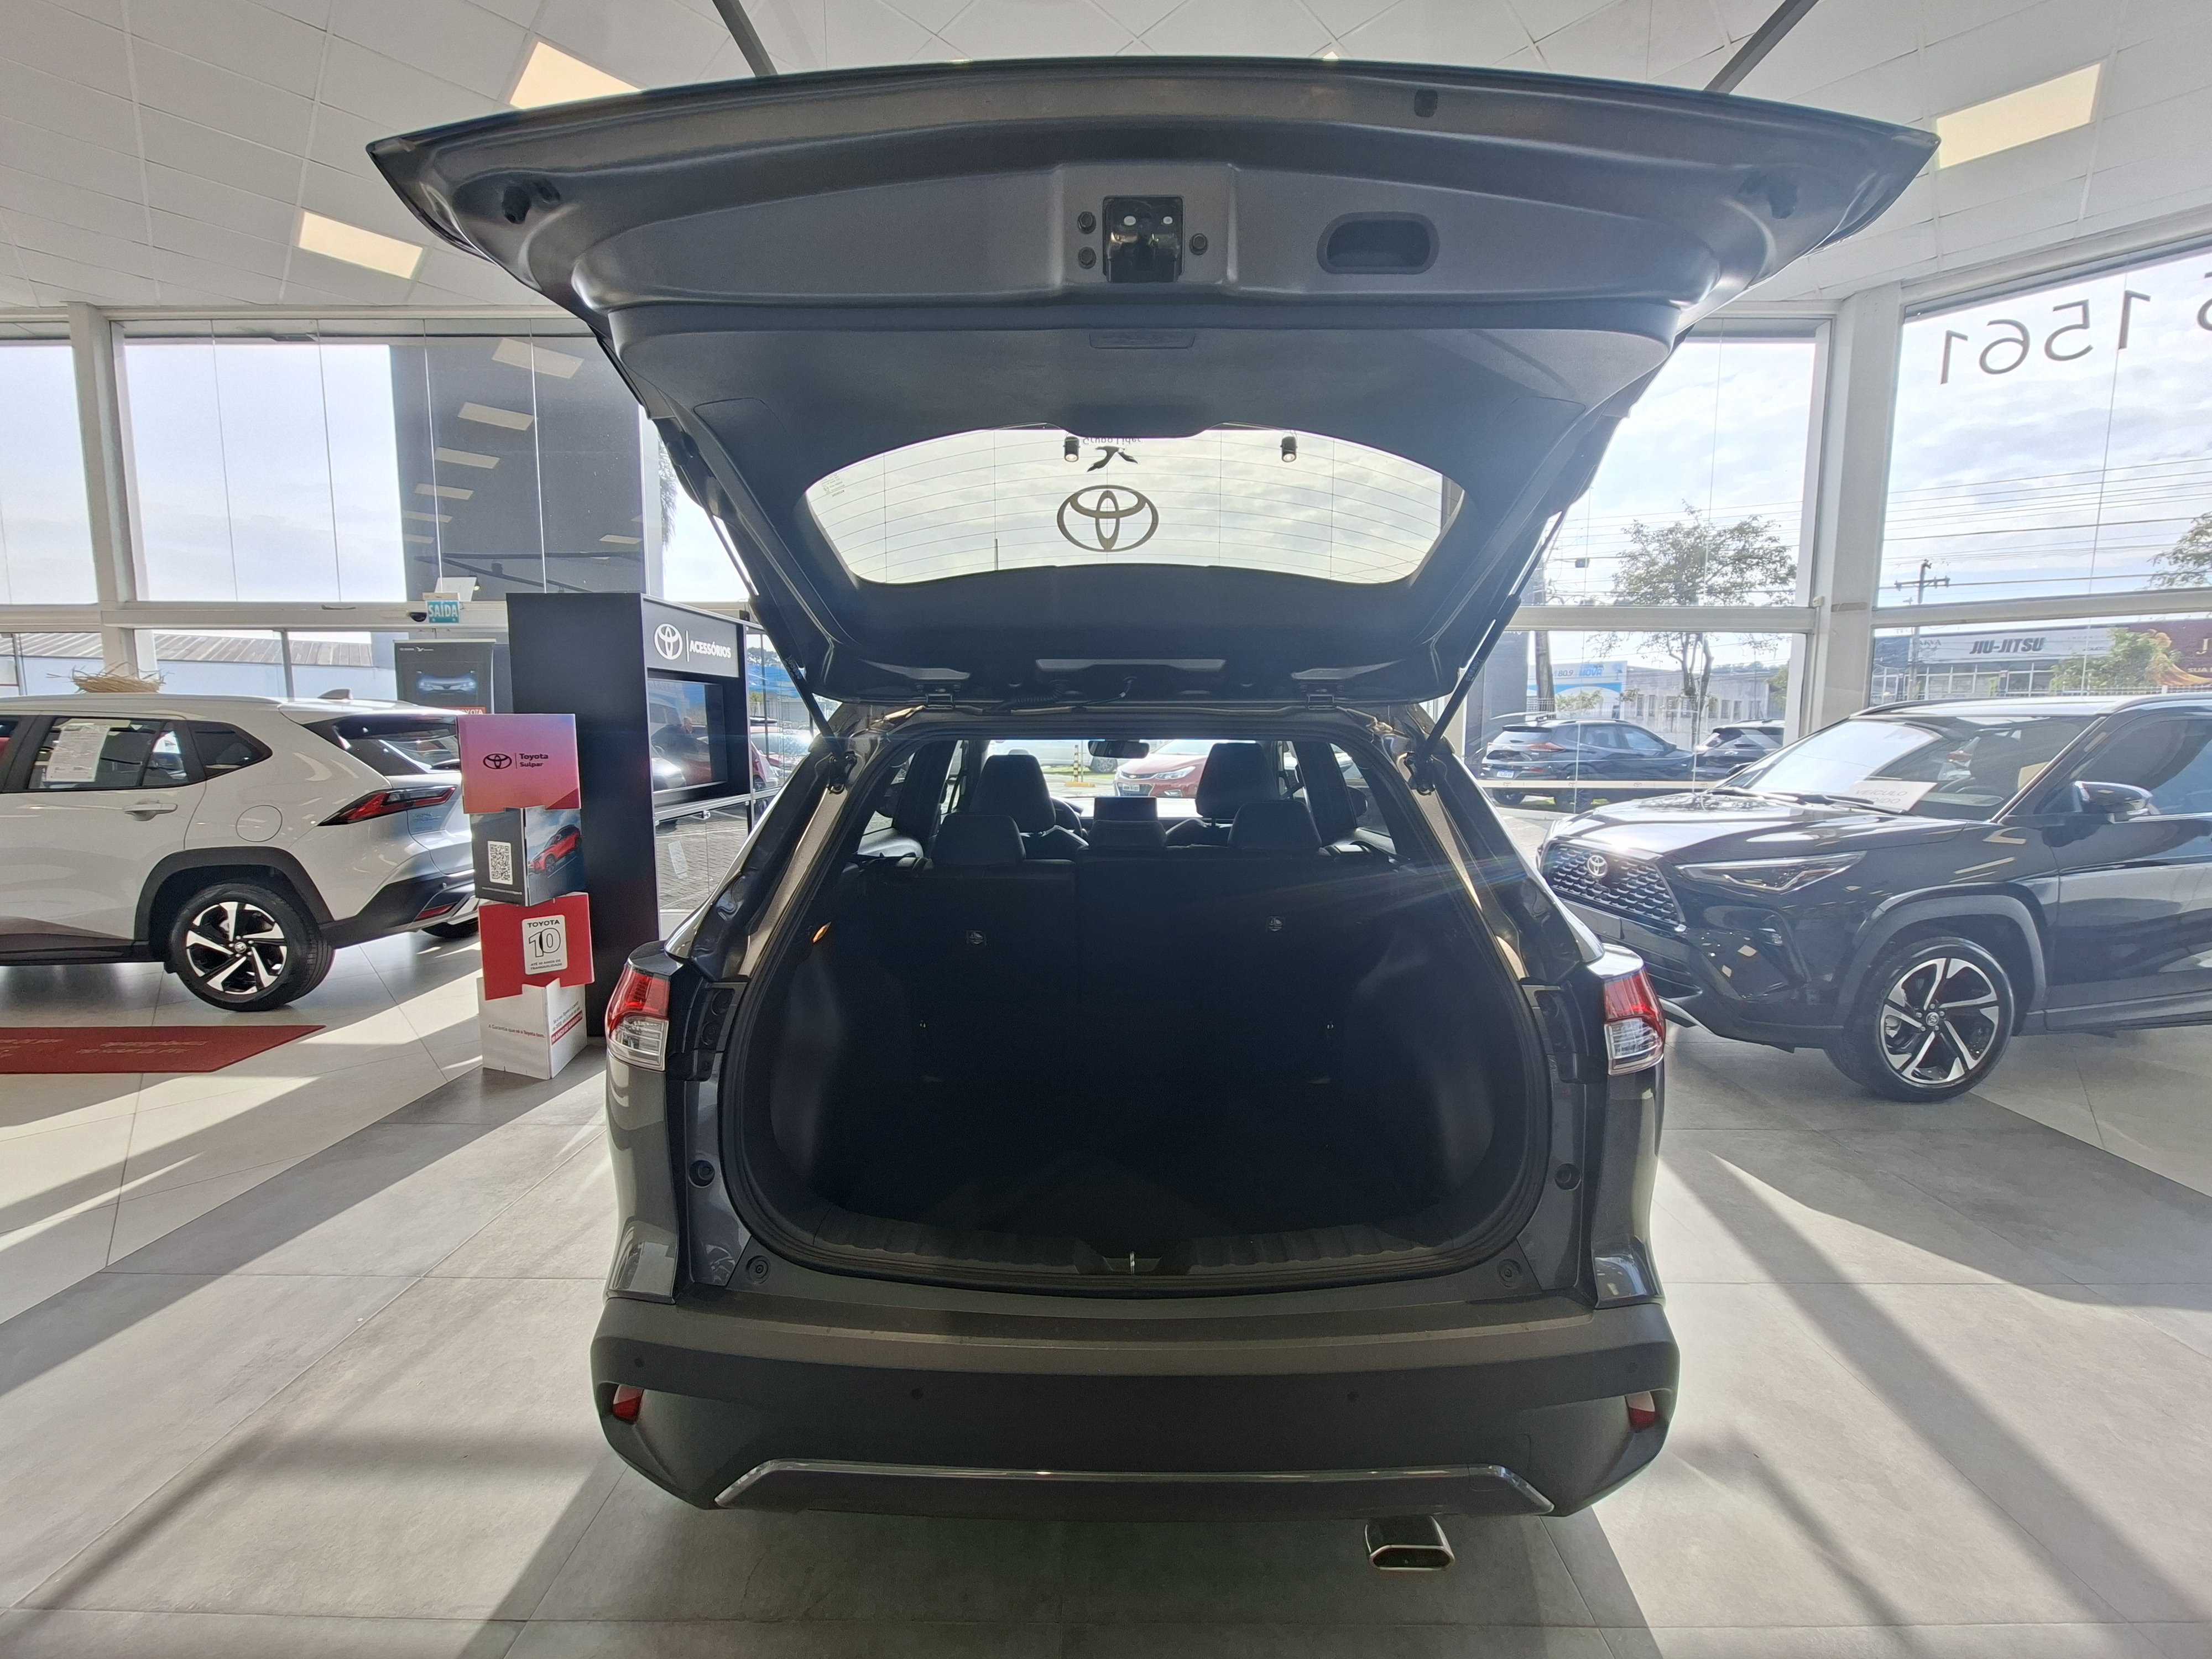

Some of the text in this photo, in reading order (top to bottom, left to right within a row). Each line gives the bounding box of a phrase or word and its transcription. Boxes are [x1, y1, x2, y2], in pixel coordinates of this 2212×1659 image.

[428, 602, 458, 618] SAÍDA
[690, 640, 732, 659] ACESSÓRIOS
[1969, 637, 2046, 654] JIU-JITSU
[527, 919, 560, 928] TOYOTA
[528, 927, 561, 958] 10
